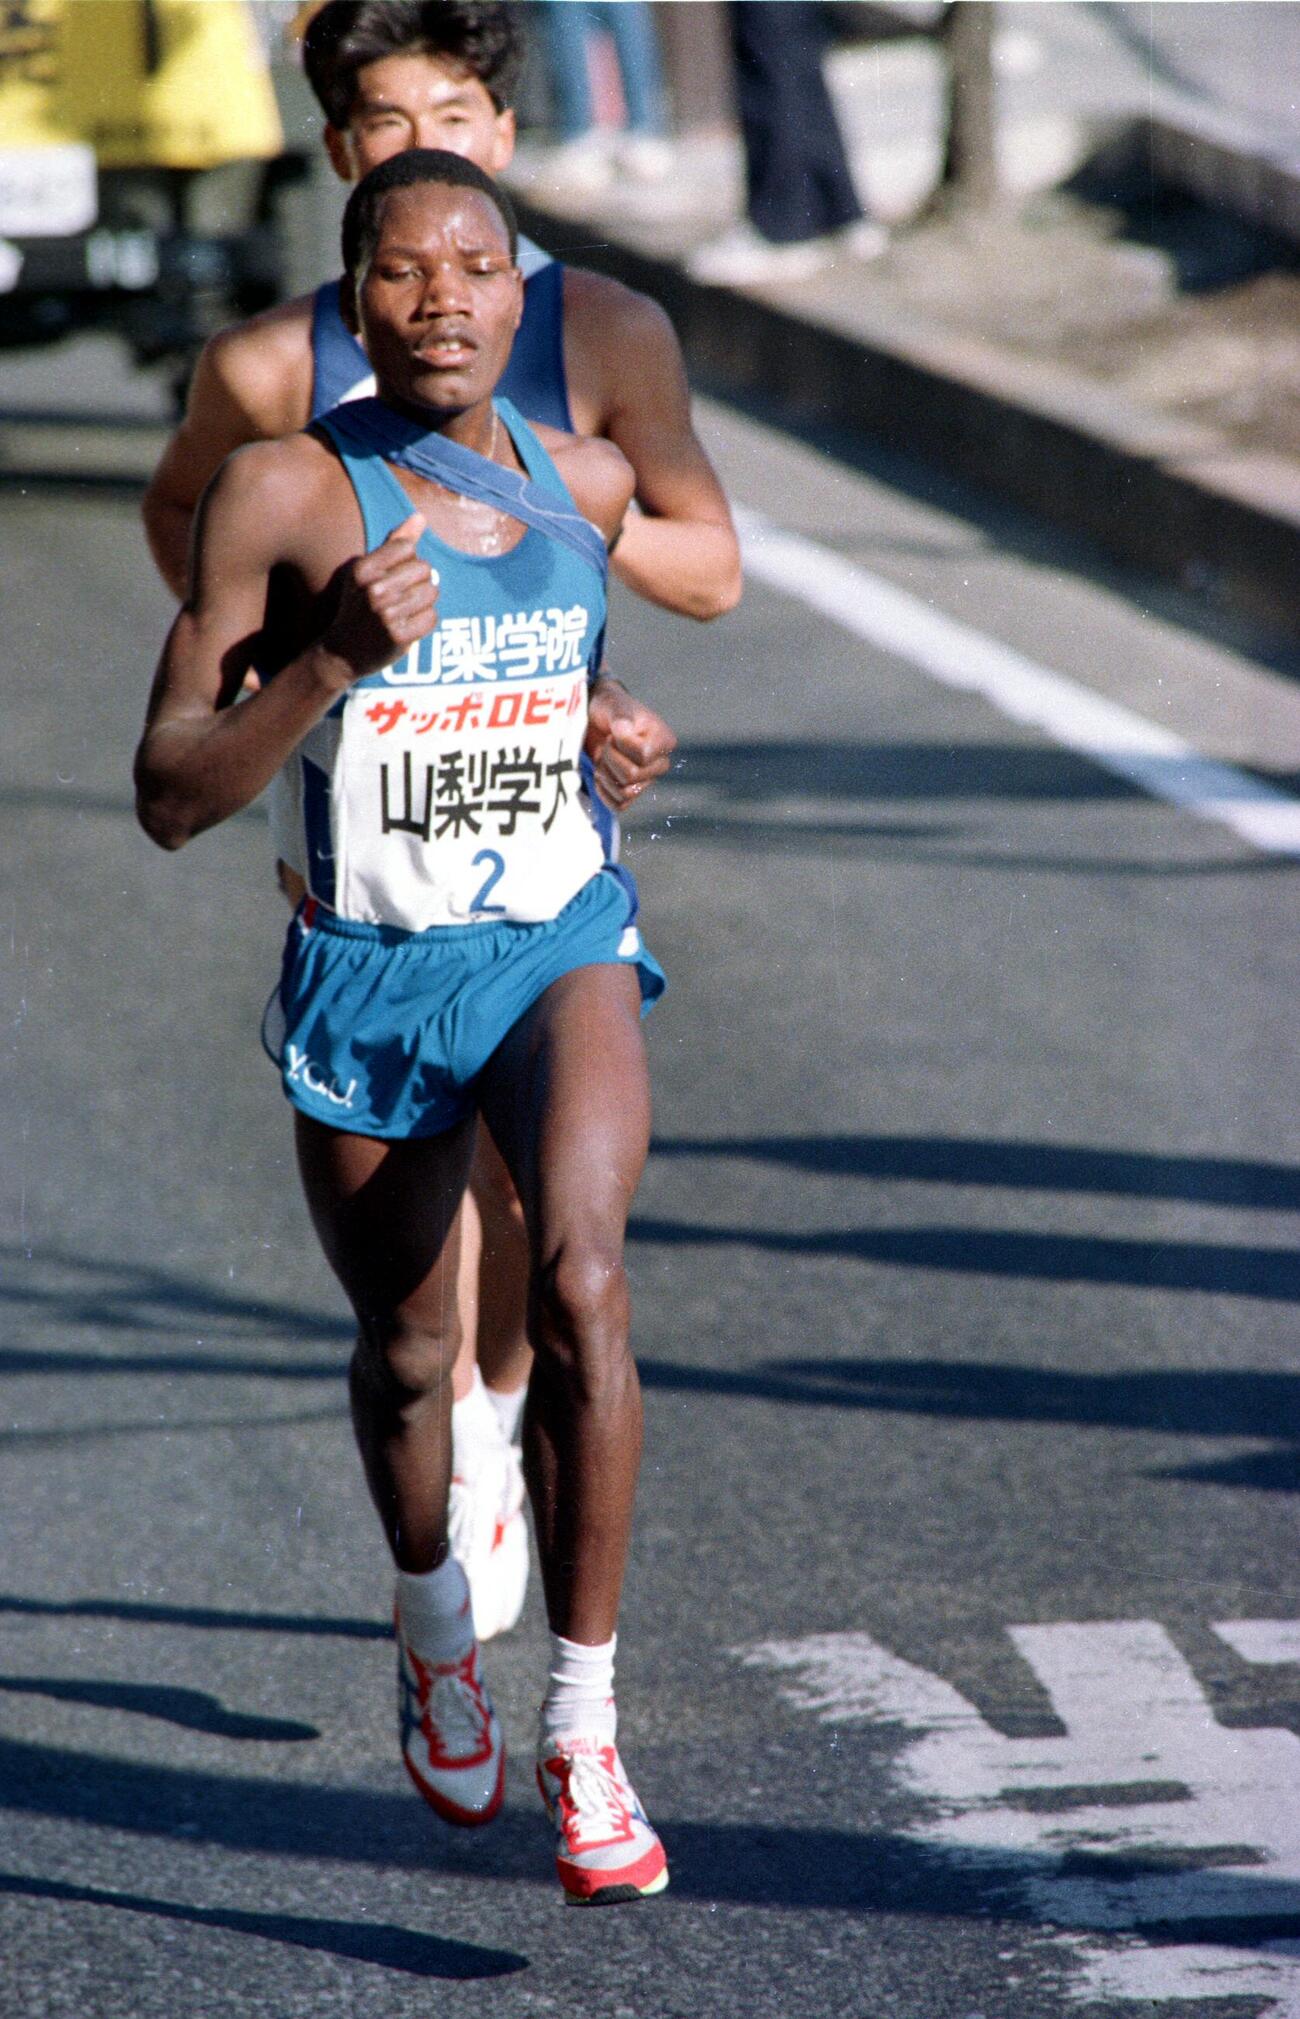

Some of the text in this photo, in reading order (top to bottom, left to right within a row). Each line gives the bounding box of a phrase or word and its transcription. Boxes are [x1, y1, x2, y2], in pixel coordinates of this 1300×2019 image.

[380, 740, 574, 843] 山梨学大
[469, 849, 507, 914] 2
